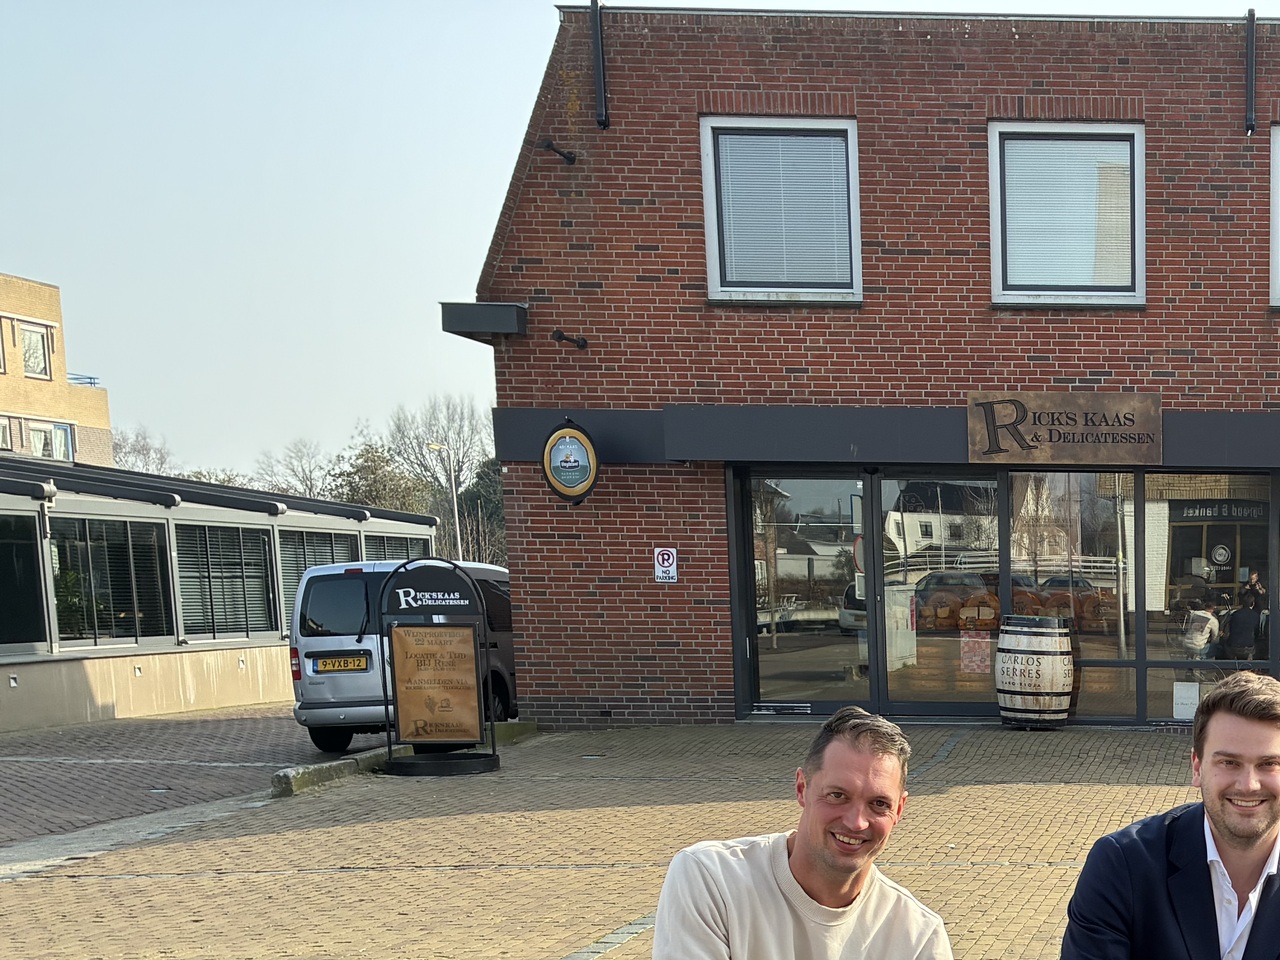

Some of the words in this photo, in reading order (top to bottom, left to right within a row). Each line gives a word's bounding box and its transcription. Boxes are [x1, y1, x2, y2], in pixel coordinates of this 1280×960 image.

[1083, 412, 1135, 427] KAAS
[1031, 432, 1042, 443] &
[1047, 429, 1155, 444] DELICATESSEN
[405, 651, 437, 659] LOCATIE
[447, 651, 466, 659] TIJD
[1001, 655, 1042, 667] CARLOS
[322, 659, 362, 669] 9-VXB-12
[1001, 666, 1041, 679] SERRES
